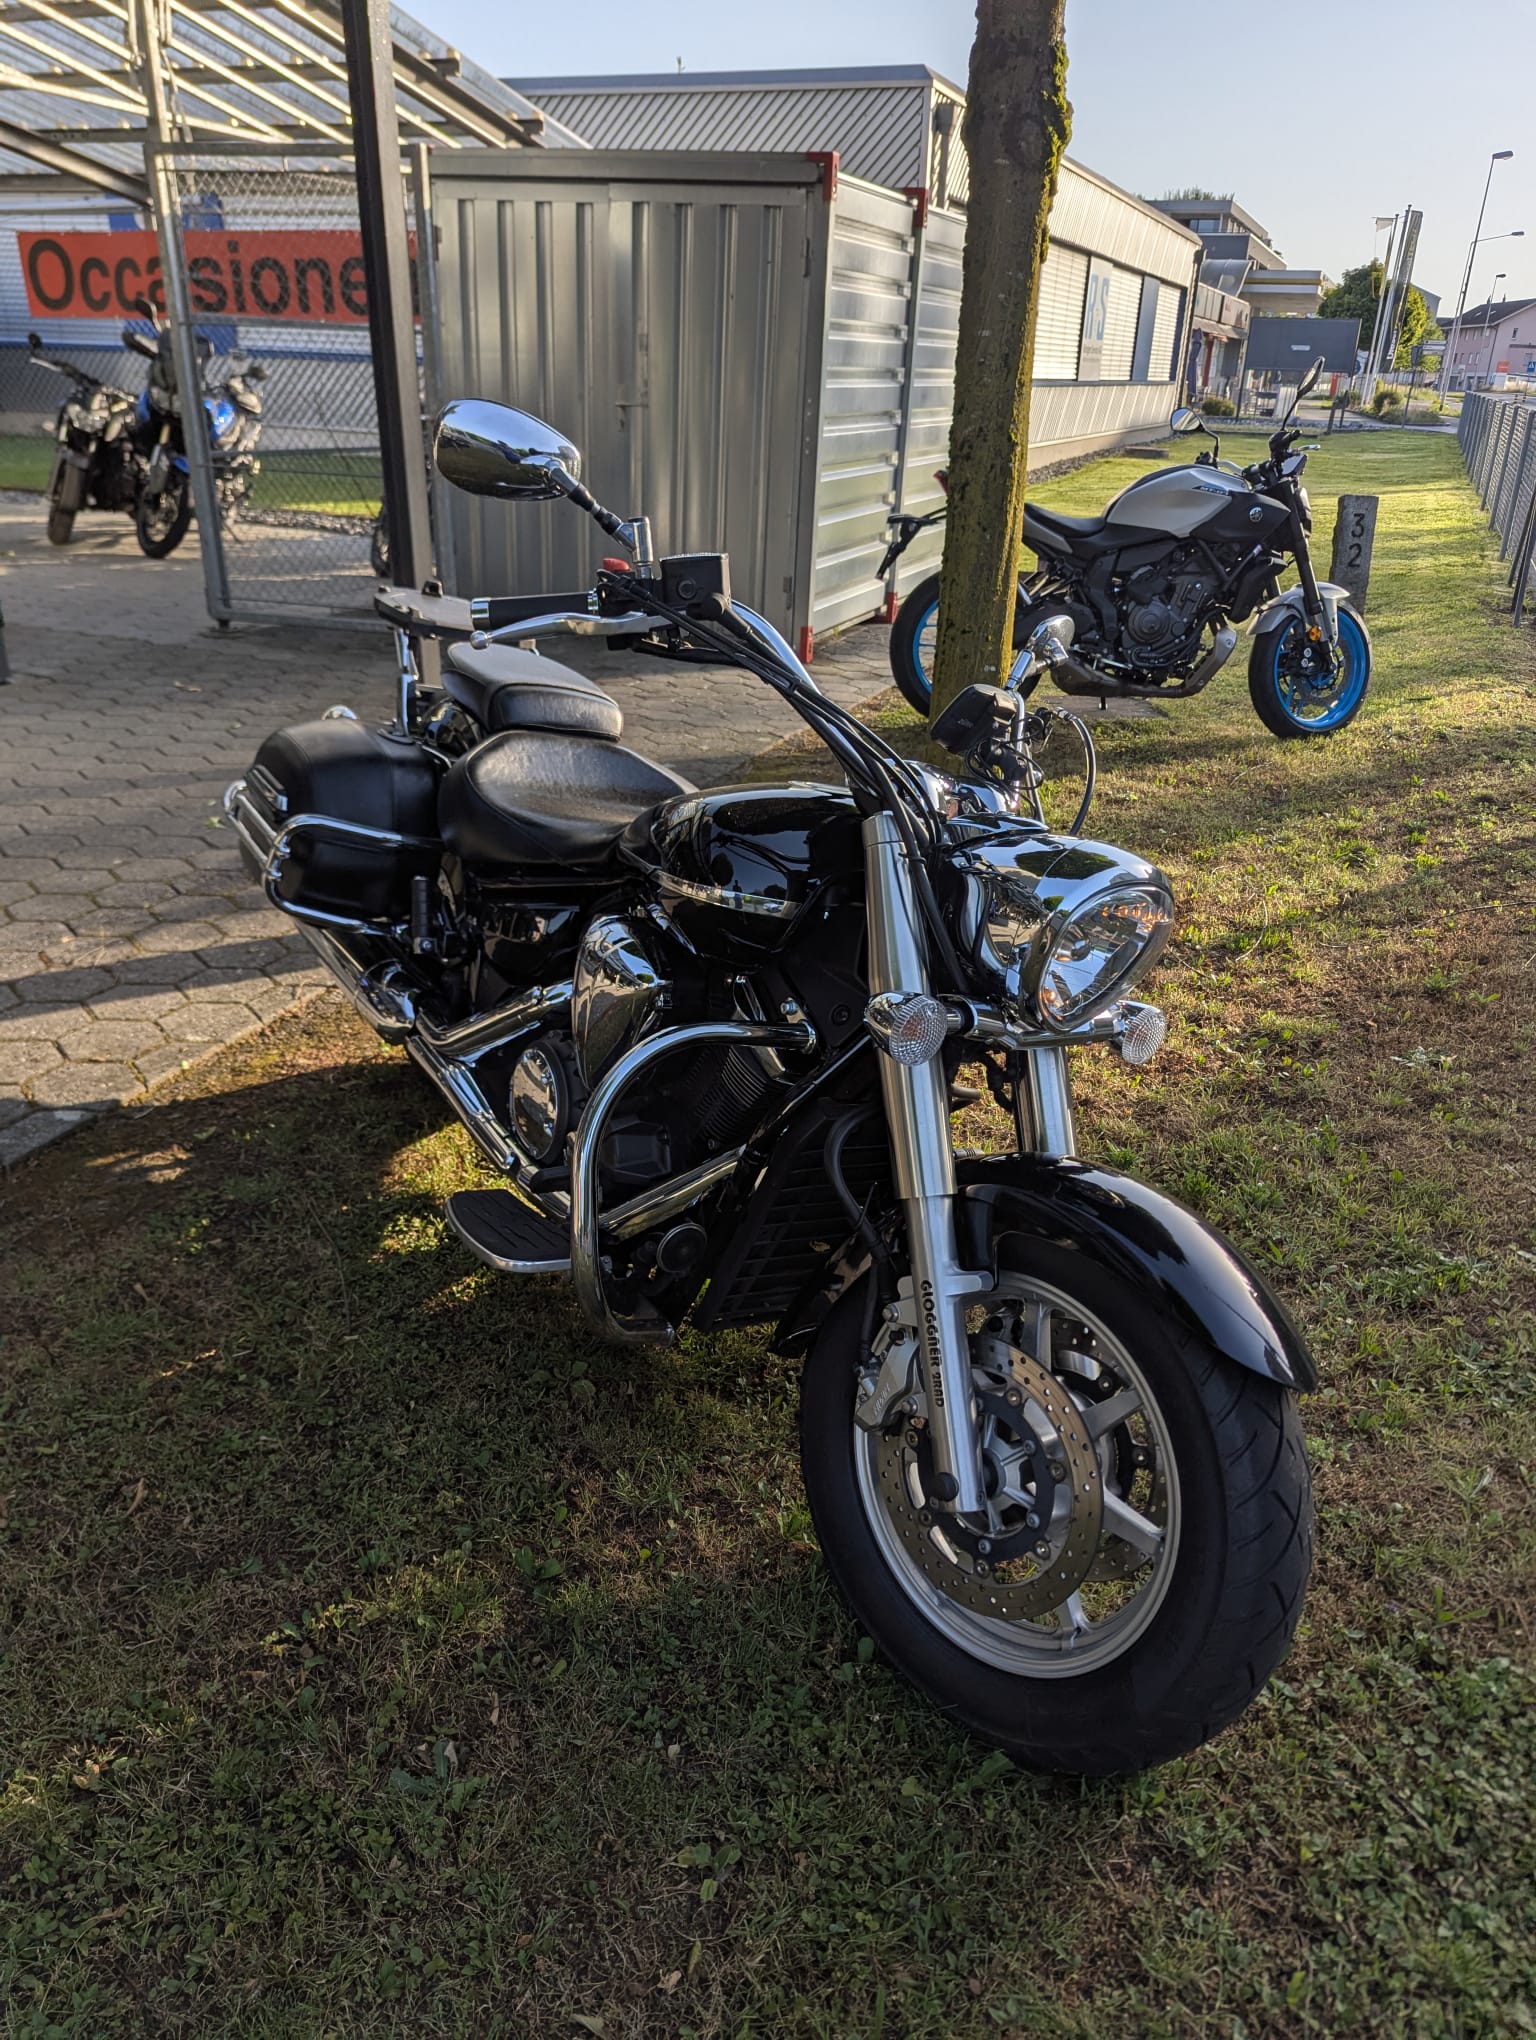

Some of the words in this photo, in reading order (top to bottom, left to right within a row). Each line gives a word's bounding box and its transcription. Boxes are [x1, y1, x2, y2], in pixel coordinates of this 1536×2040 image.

[28, 238, 420, 316] Occasione
[920, 1279, 942, 1367] GLOGGNER
[931, 1371, 944, 1408] 2RAD
